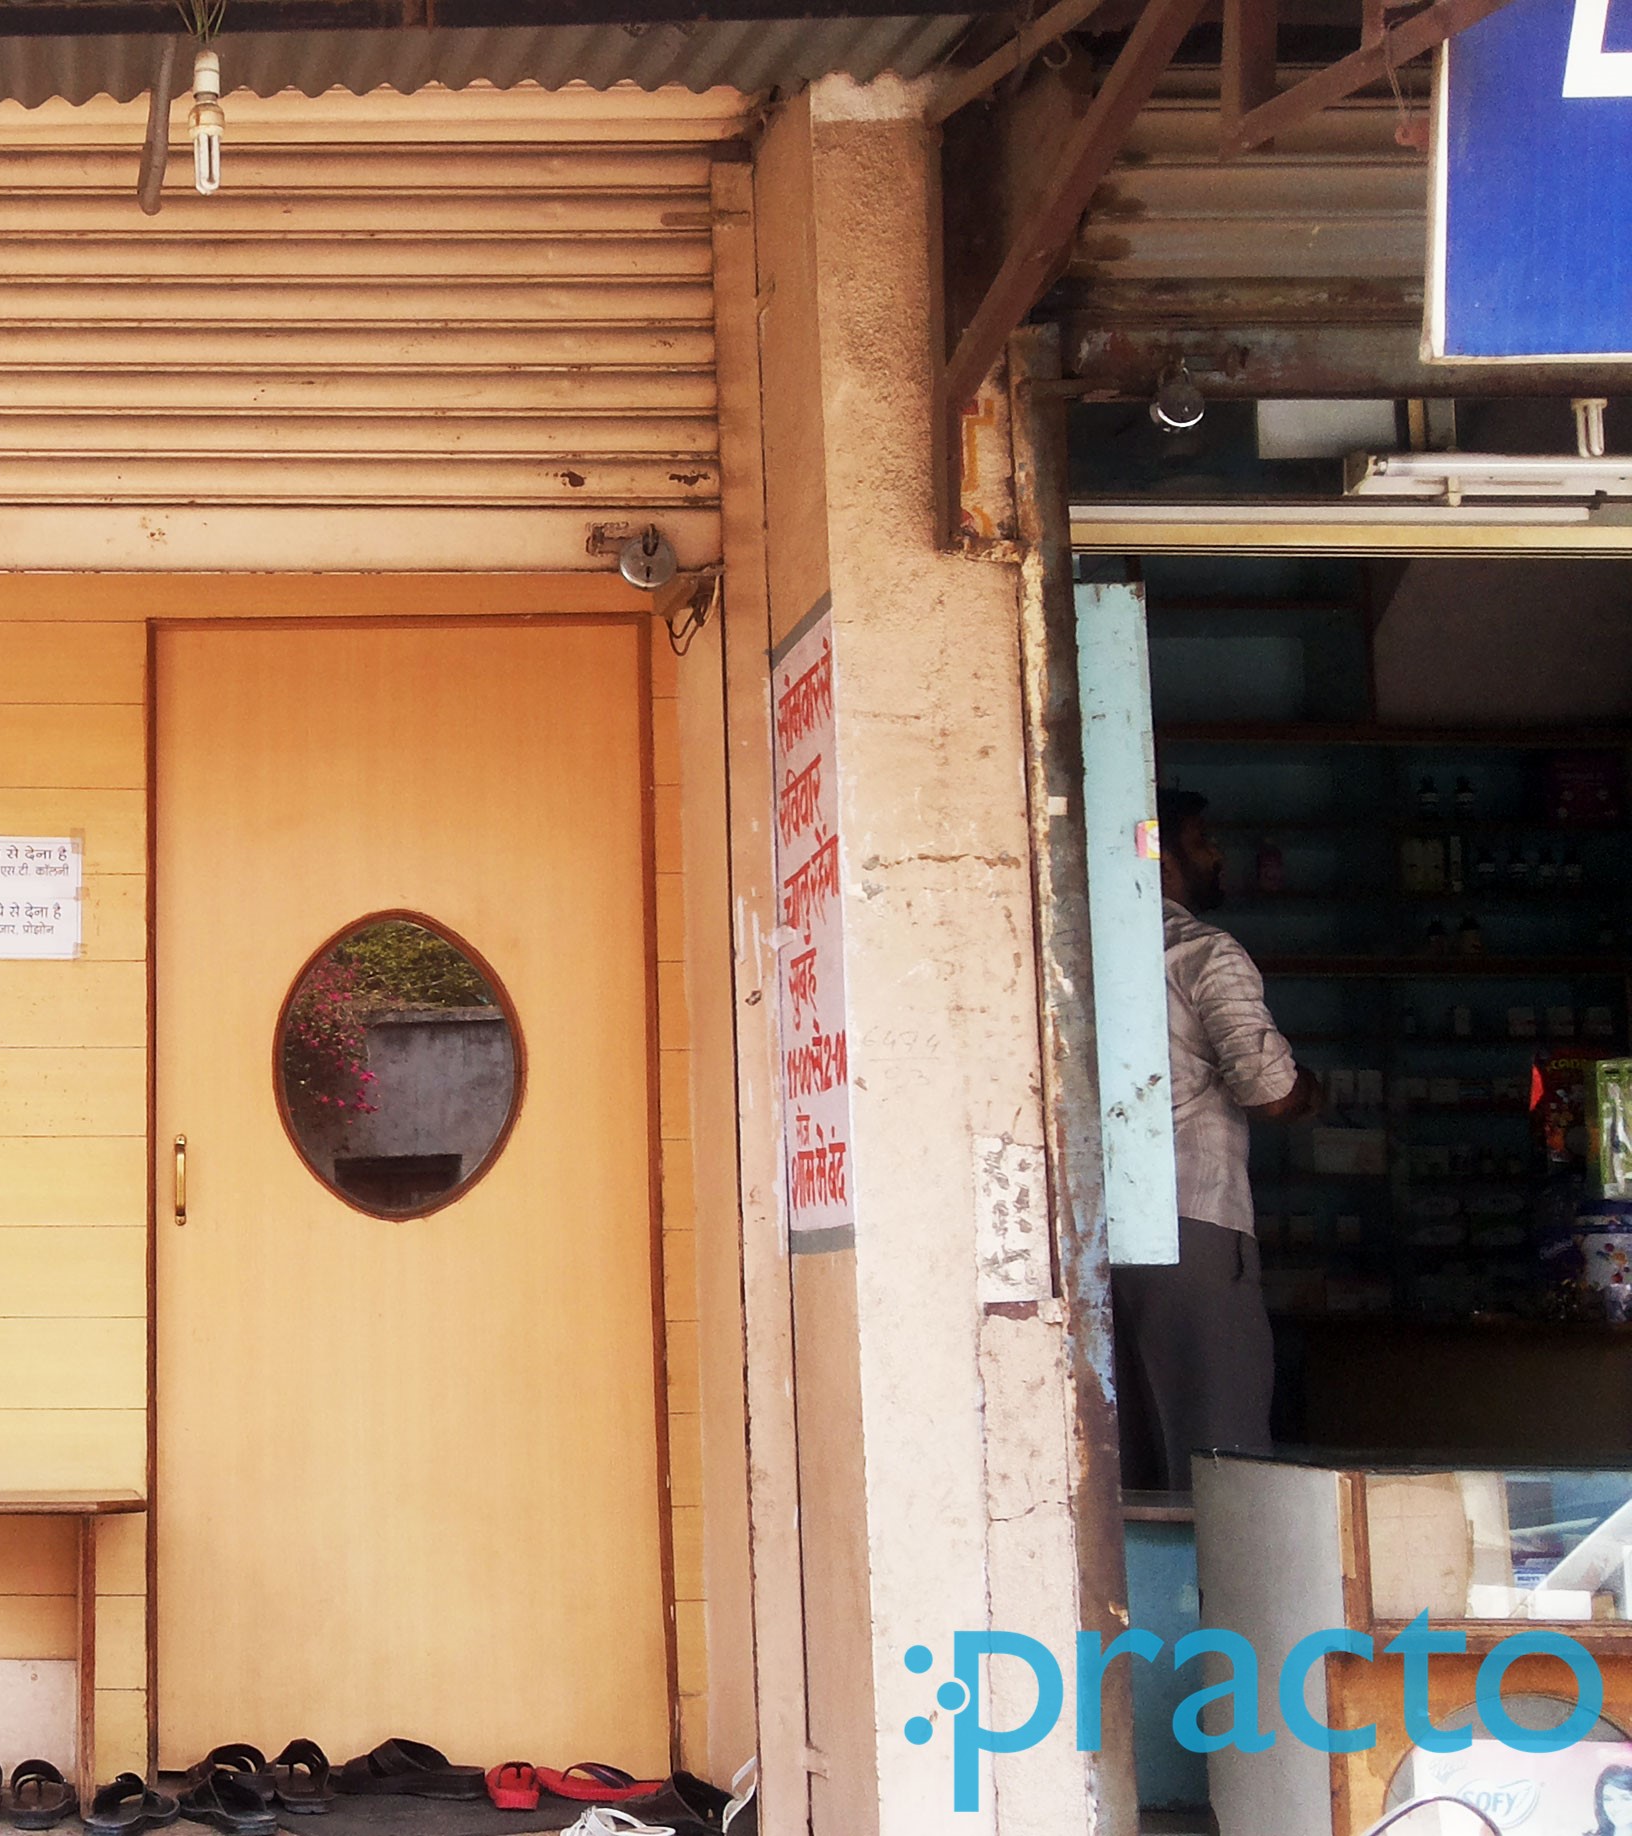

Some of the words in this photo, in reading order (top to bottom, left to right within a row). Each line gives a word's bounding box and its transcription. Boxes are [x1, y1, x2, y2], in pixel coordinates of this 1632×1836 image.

[779, 754, 822, 849] रविवार
[7, 845, 19, 860] से
[24, 845, 52, 861] देना
[58, 846, 67, 862] है
[9, 902, 20, 918] से
[24, 902, 49, 919] देना
[53, 902, 62, 920] है
[788, 947, 817, 1031] सुबह
[1462, 1790, 1519, 1818] SOFY
